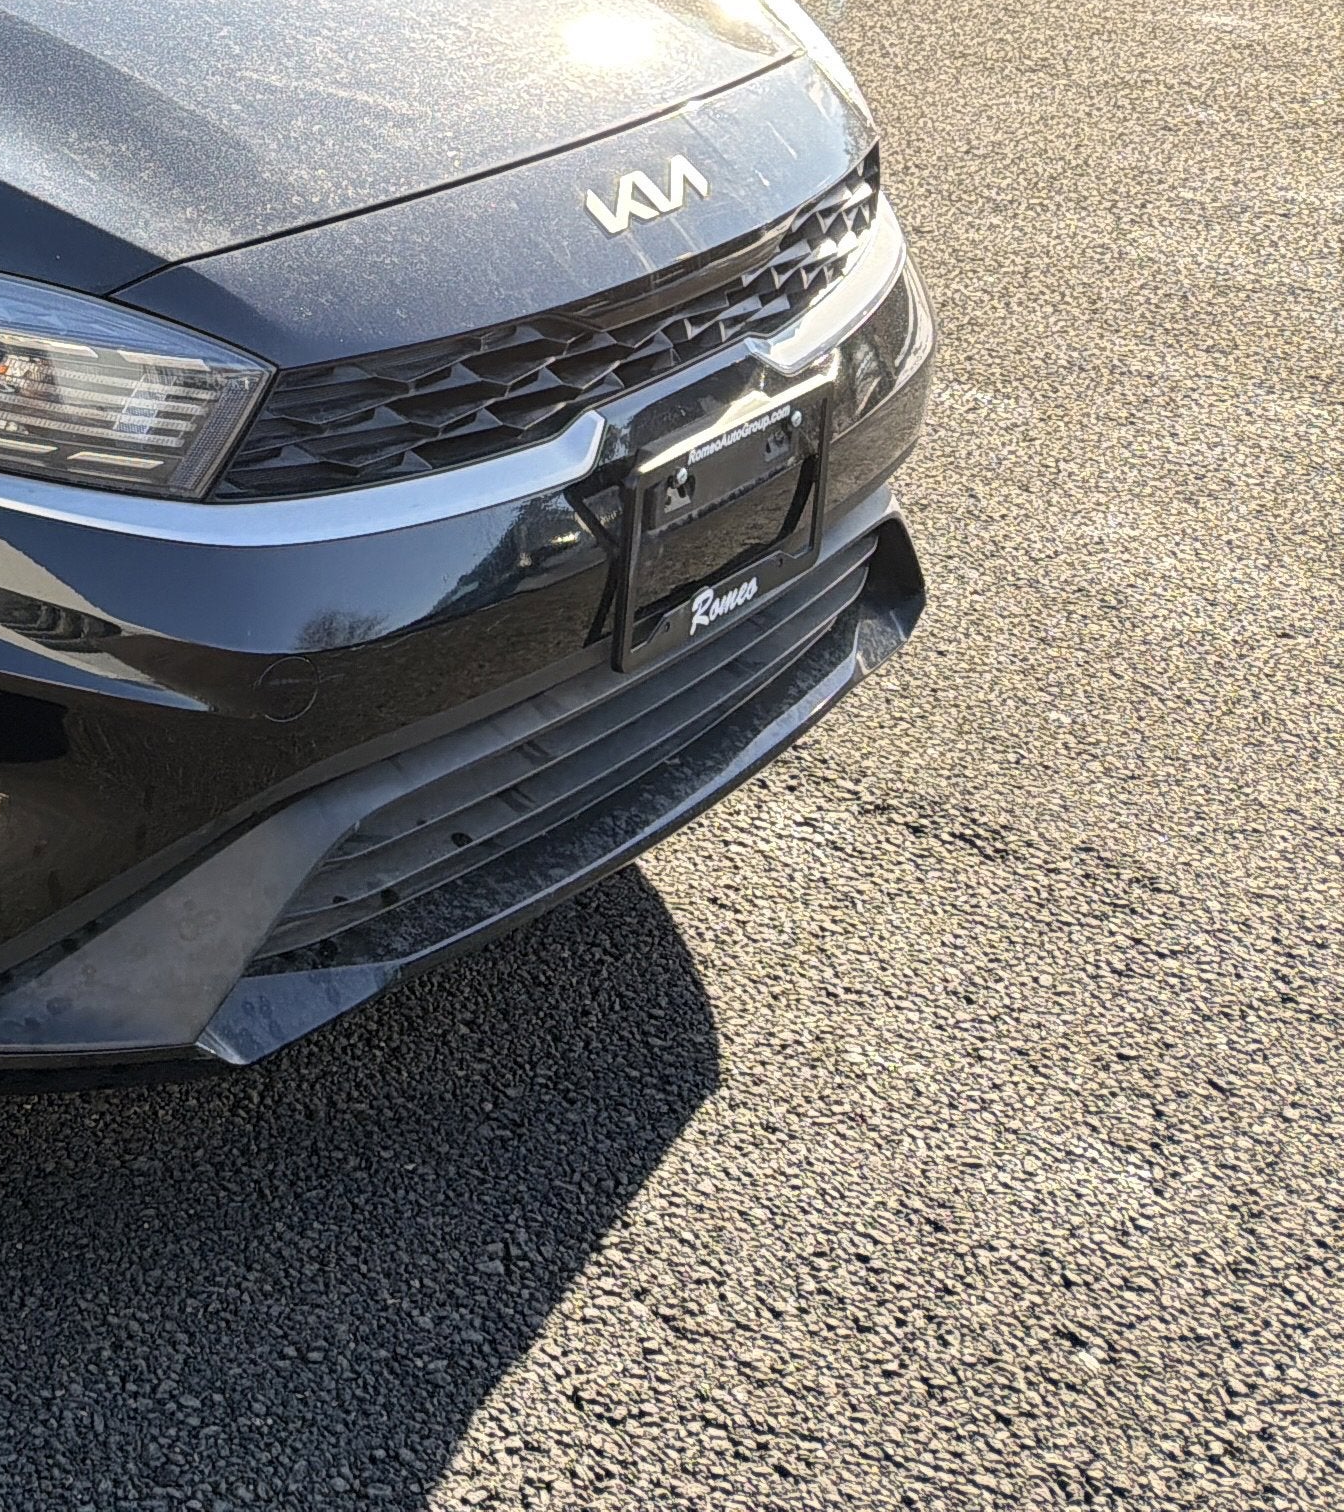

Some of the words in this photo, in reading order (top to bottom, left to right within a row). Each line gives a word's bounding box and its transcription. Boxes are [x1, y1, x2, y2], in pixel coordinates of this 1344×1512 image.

[585, 154, 709, 237] KIA
[687, 404, 791, 466] RomeoAutoGroup.com
[689, 577, 758, 636] Romeo
